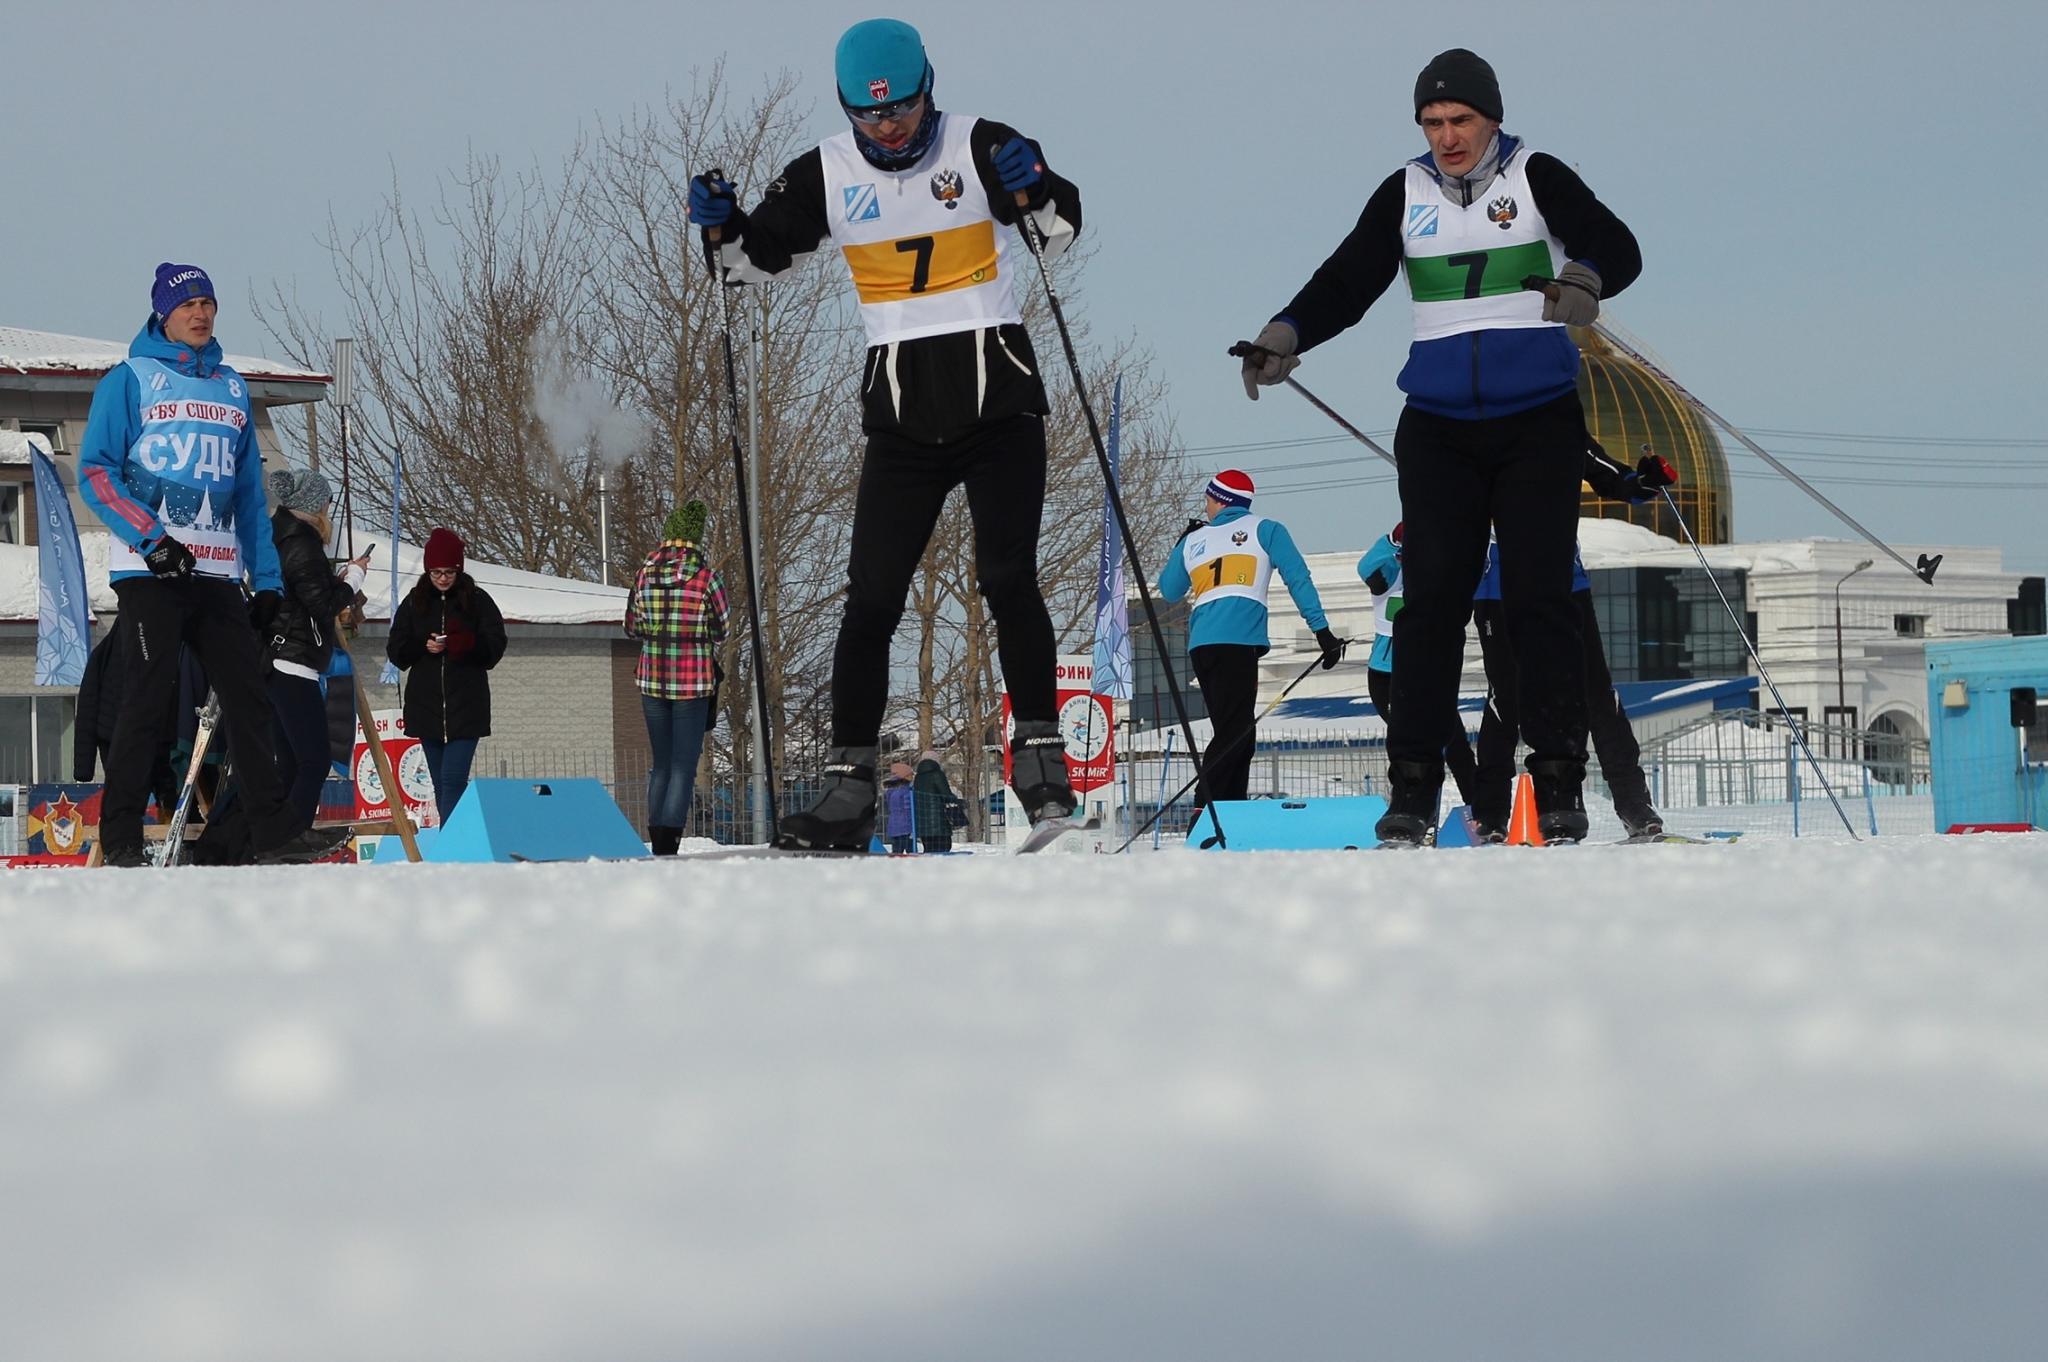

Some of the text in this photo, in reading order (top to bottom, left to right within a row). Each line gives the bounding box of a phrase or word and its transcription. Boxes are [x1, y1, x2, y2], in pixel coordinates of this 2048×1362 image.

[895, 236, 934, 293] 7
[1448, 252, 1488, 299] 7
[228, 378, 242, 398] 8
[186, 402, 227, 422] СШОР
[139, 432, 236, 482] СУДЬ
[1209, 557, 1223, 587] 1
[1238, 574, 1246, 585] 3
[1056, 665, 1093, 681] ФИНИ
